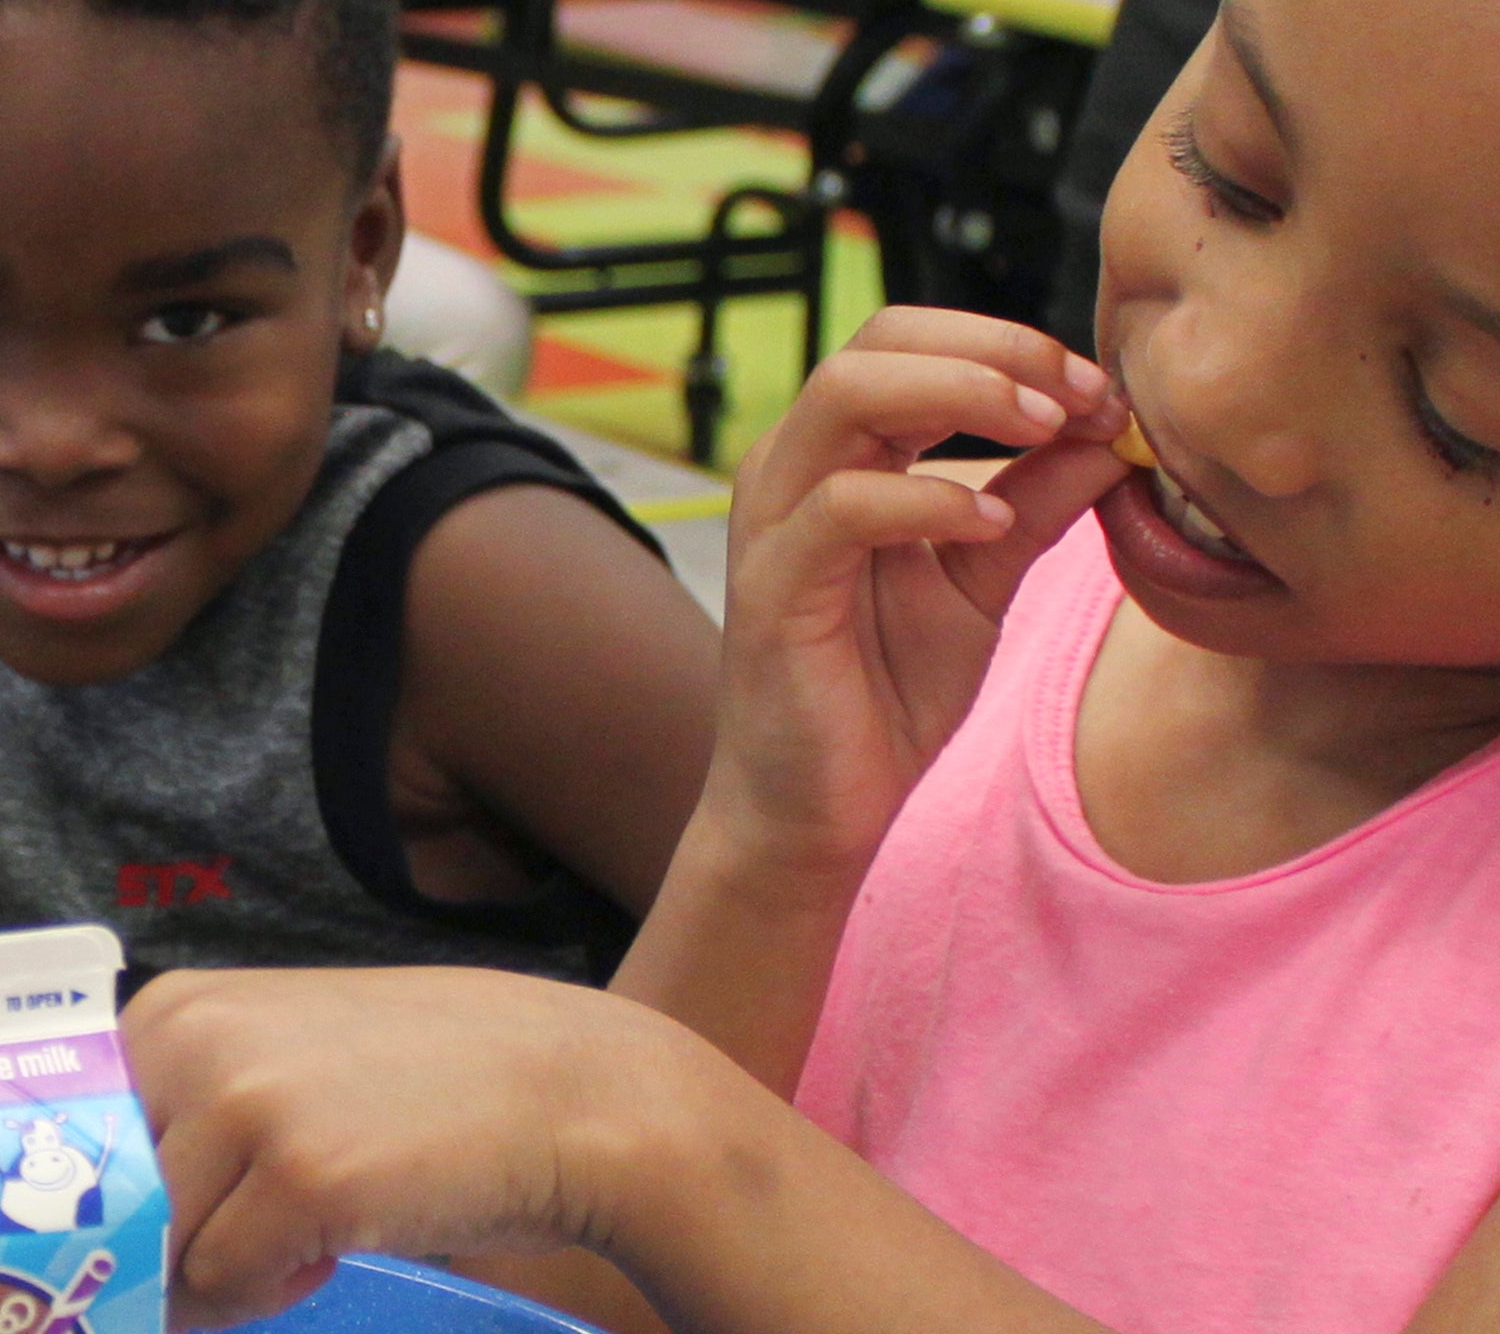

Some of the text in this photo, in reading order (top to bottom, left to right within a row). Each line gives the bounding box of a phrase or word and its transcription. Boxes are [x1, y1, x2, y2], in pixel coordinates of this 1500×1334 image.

[6, 991, 64, 1012] TO OPEN
[19, 1043, 83, 1080] milk
